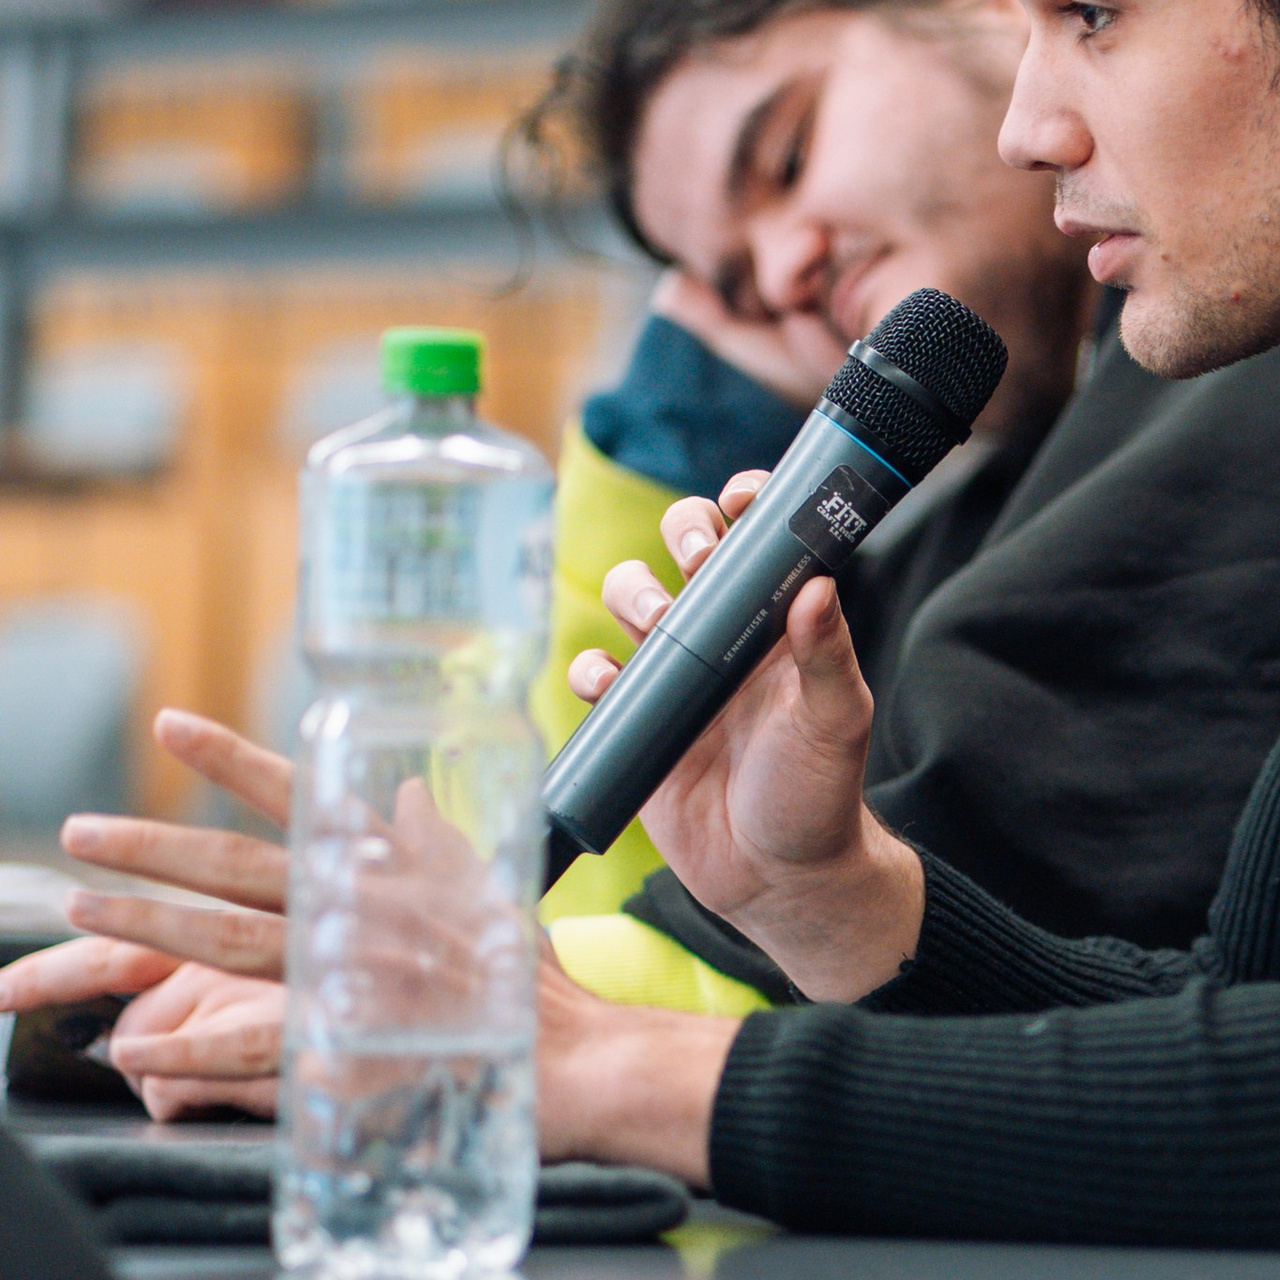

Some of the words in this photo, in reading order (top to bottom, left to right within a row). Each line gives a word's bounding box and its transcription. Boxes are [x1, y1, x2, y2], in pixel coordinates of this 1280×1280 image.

[816, 505, 837, 524] CRAFT
[723, 608, 769, 663] SENNHEISER
[771, 590, 783, 603] XS
[779, 553, 812, 592] WIRELESS
